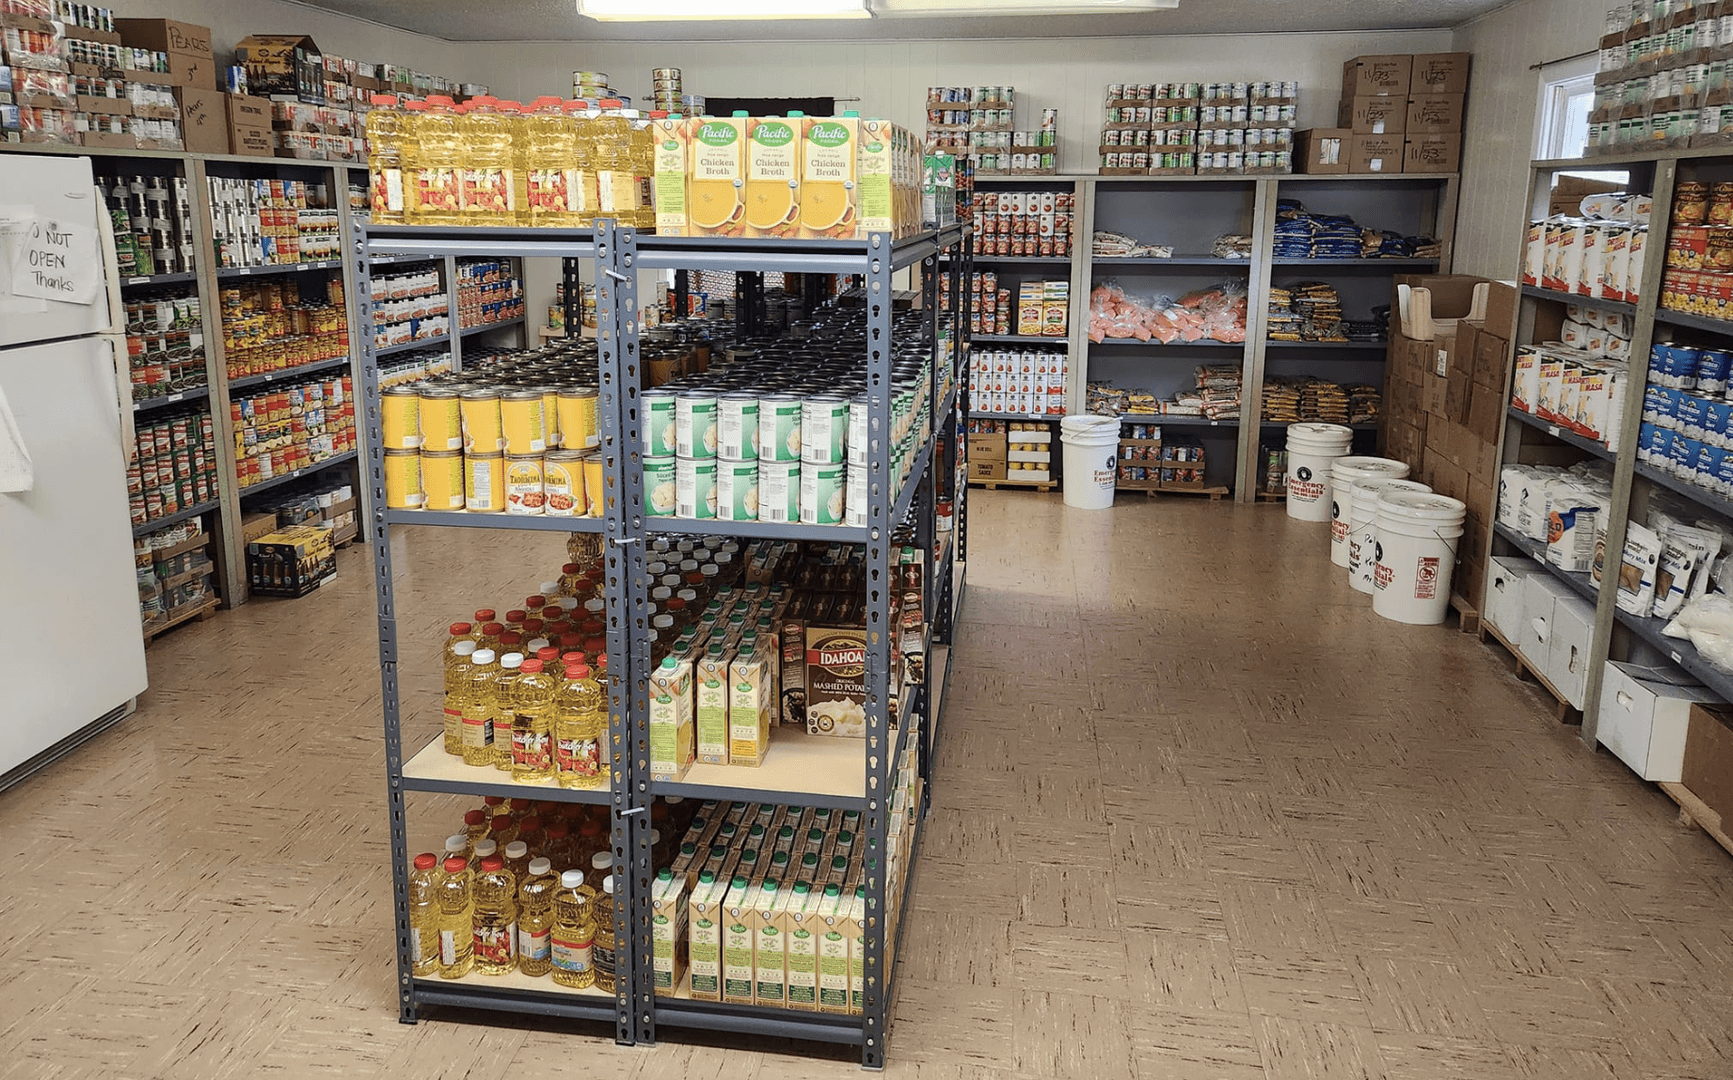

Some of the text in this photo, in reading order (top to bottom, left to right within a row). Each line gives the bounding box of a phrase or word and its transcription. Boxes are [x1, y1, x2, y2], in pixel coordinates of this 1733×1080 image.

[701, 124, 734, 139] Pacific
[757, 124, 791, 140] Pacific
[812, 125, 847, 140] Pacific
[700, 158, 734, 166] Chicken
[755, 158, 789, 168] Chicken
[810, 159, 846, 168] Chicken
[761, 168, 785, 176] Broth
[816, 168, 840, 177] Broth
[46, 231, 73, 248] NOT
[30, 250, 65, 268] OPEN
[31, 271, 74, 291] Thanks
[814, 682, 843, 690] MASHED
